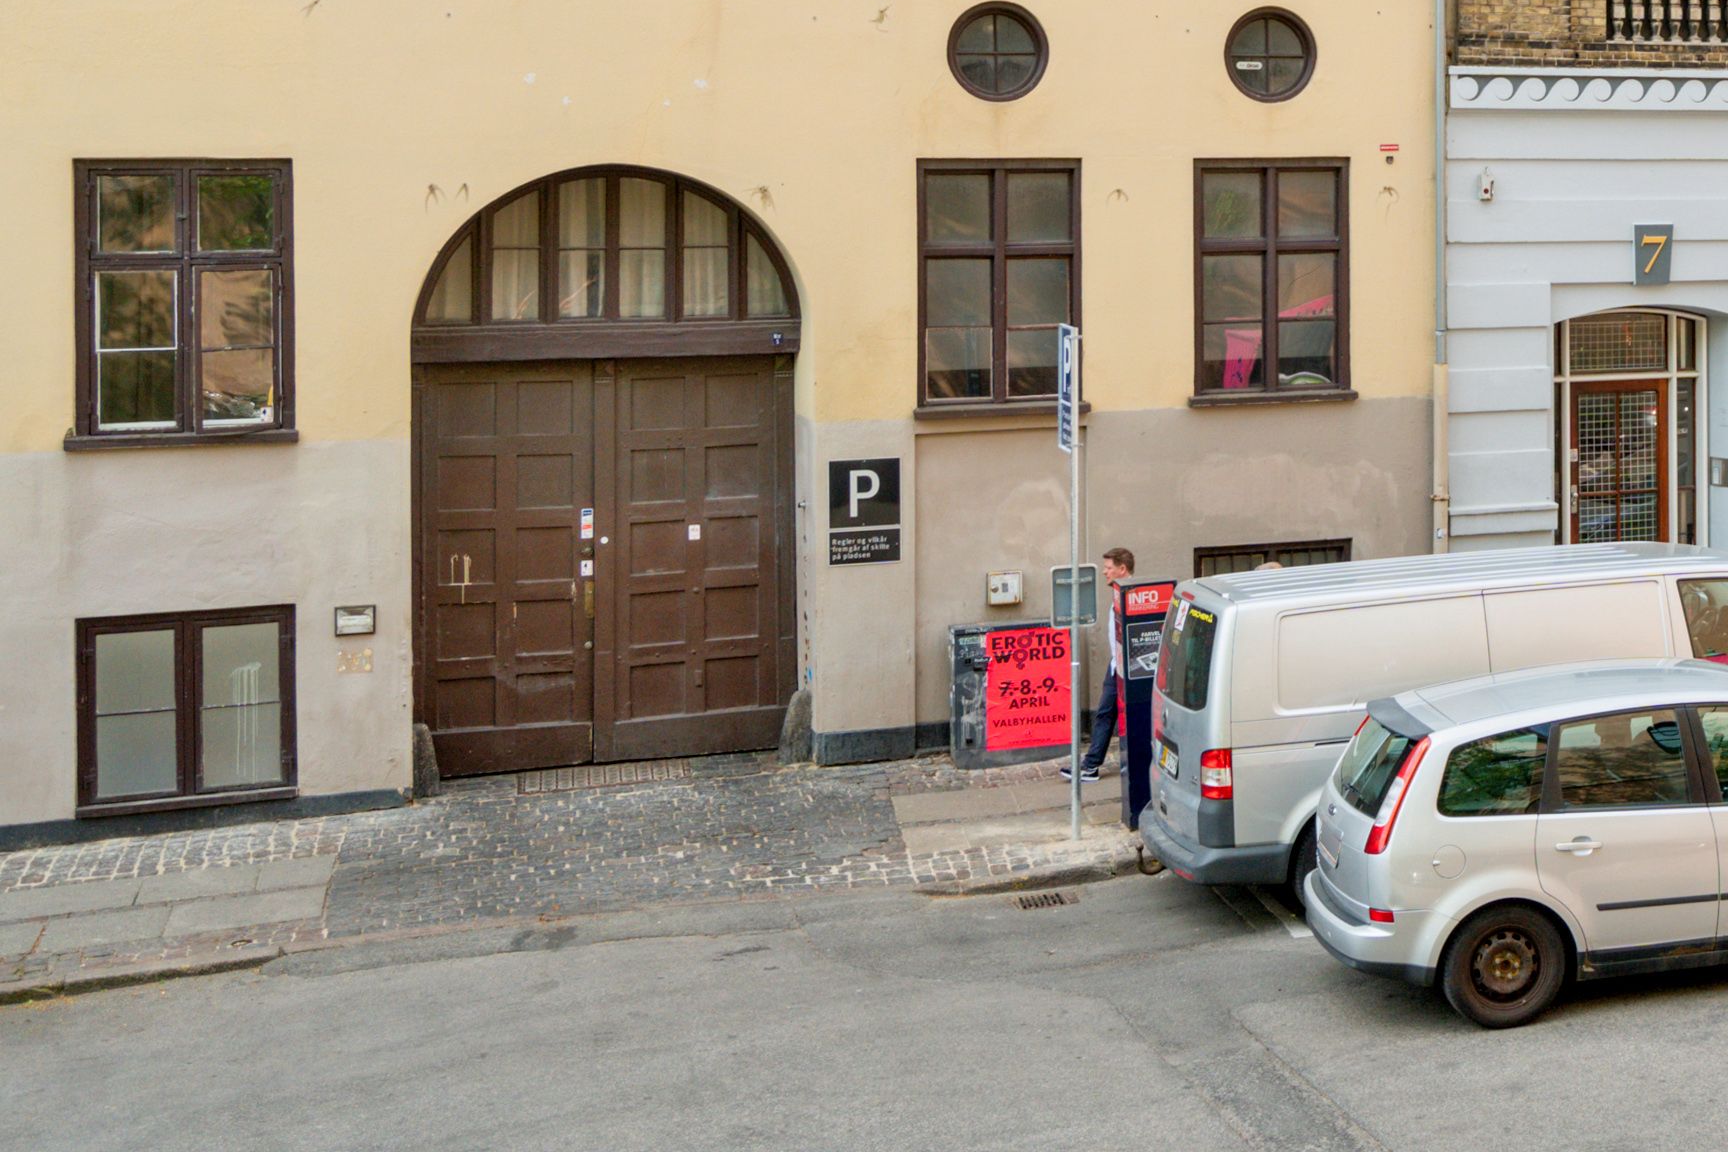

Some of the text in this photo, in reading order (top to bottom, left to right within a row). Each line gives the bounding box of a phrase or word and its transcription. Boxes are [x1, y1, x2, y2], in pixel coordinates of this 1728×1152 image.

[1641, 234, 1667, 273] 7
[849, 469, 880, 517] P
[832, 538, 856, 547] Regler
[868, 535, 888, 544] vilkår
[843, 551, 871, 560] pladsen
[1128, 590, 1159, 604] INFO
[992, 632, 1064, 650] EROTIC
[993, 647, 1065, 665] WORLD
[1009, 696, 1050, 709] APRIL
[993, 714, 1066, 728] VALBYHALLEN
